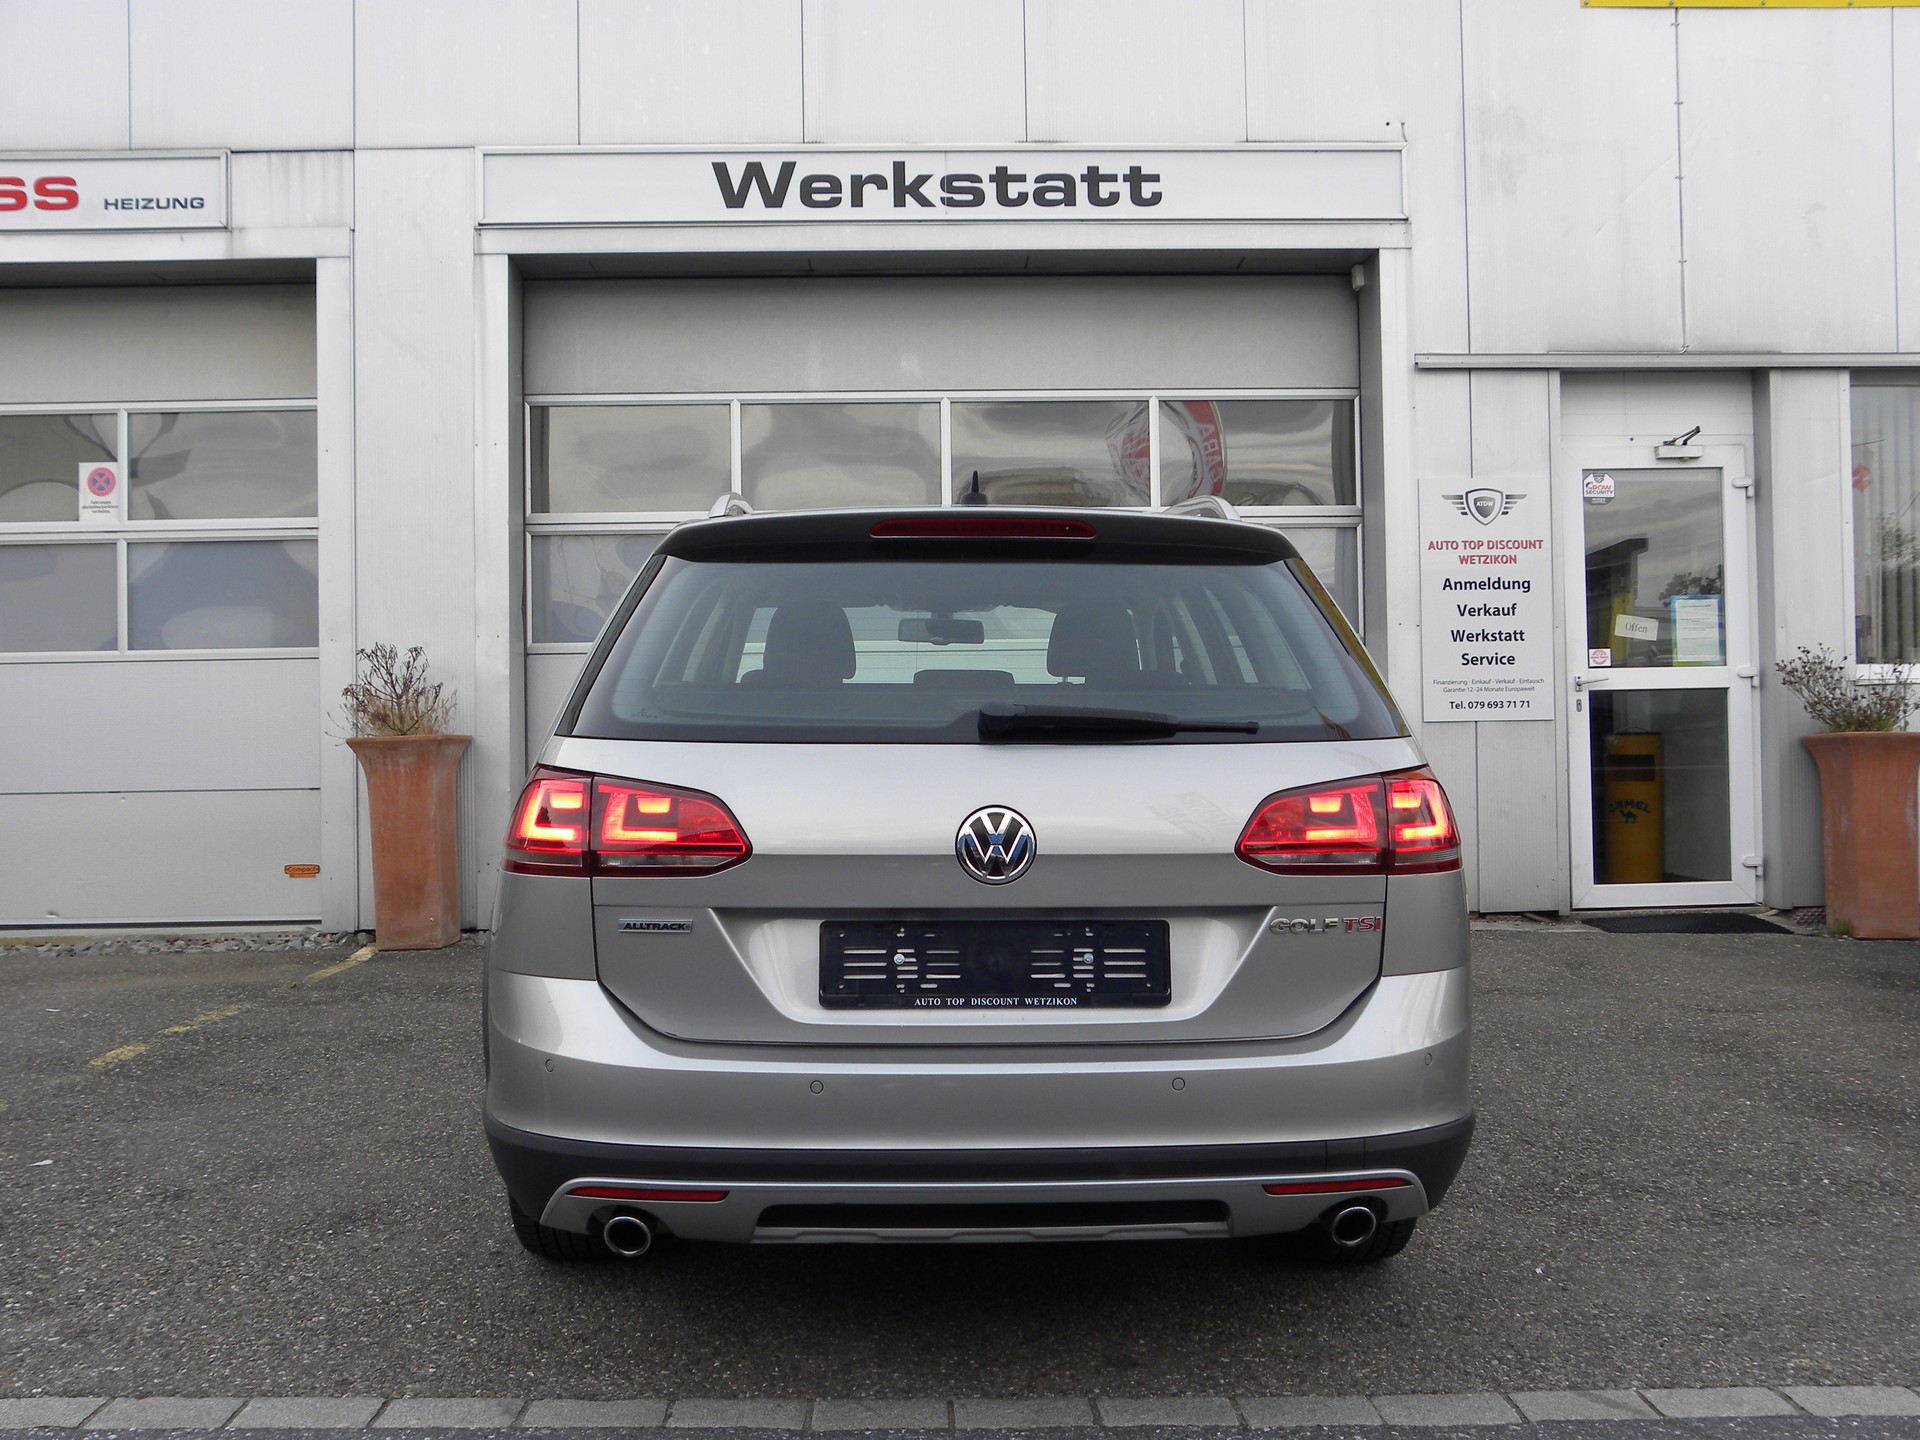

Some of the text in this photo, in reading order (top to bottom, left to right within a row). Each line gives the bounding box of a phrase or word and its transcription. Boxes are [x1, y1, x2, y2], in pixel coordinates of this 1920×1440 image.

[711, 160, 1163, 208] Werkstatt
[104, 197, 205, 210] HEIZUNG
[1428, 539, 1544, 550] AUTO TOP DISCOUNT
[1458, 554, 1517, 565] WETZIKON
[1442, 577, 1531, 593] Anmeldung
[1457, 603, 1517, 617] Verkauf
[1625, 621, 1648, 633] Offen
[1451, 629, 1525, 642] Werkstatt
[1461, 652, 1516, 666] Service
[1449, 700, 1530, 709] Tel. 079 693 71 71
[1608, 799, 1651, 814] CAMEL
[623, 922, 686, 931] ALLTRACK
[1270, 916, 1381, 934] GOLF TSI
[914, 997, 1077, 1006] AUTO TOP DISCOUNT WETZIKON
